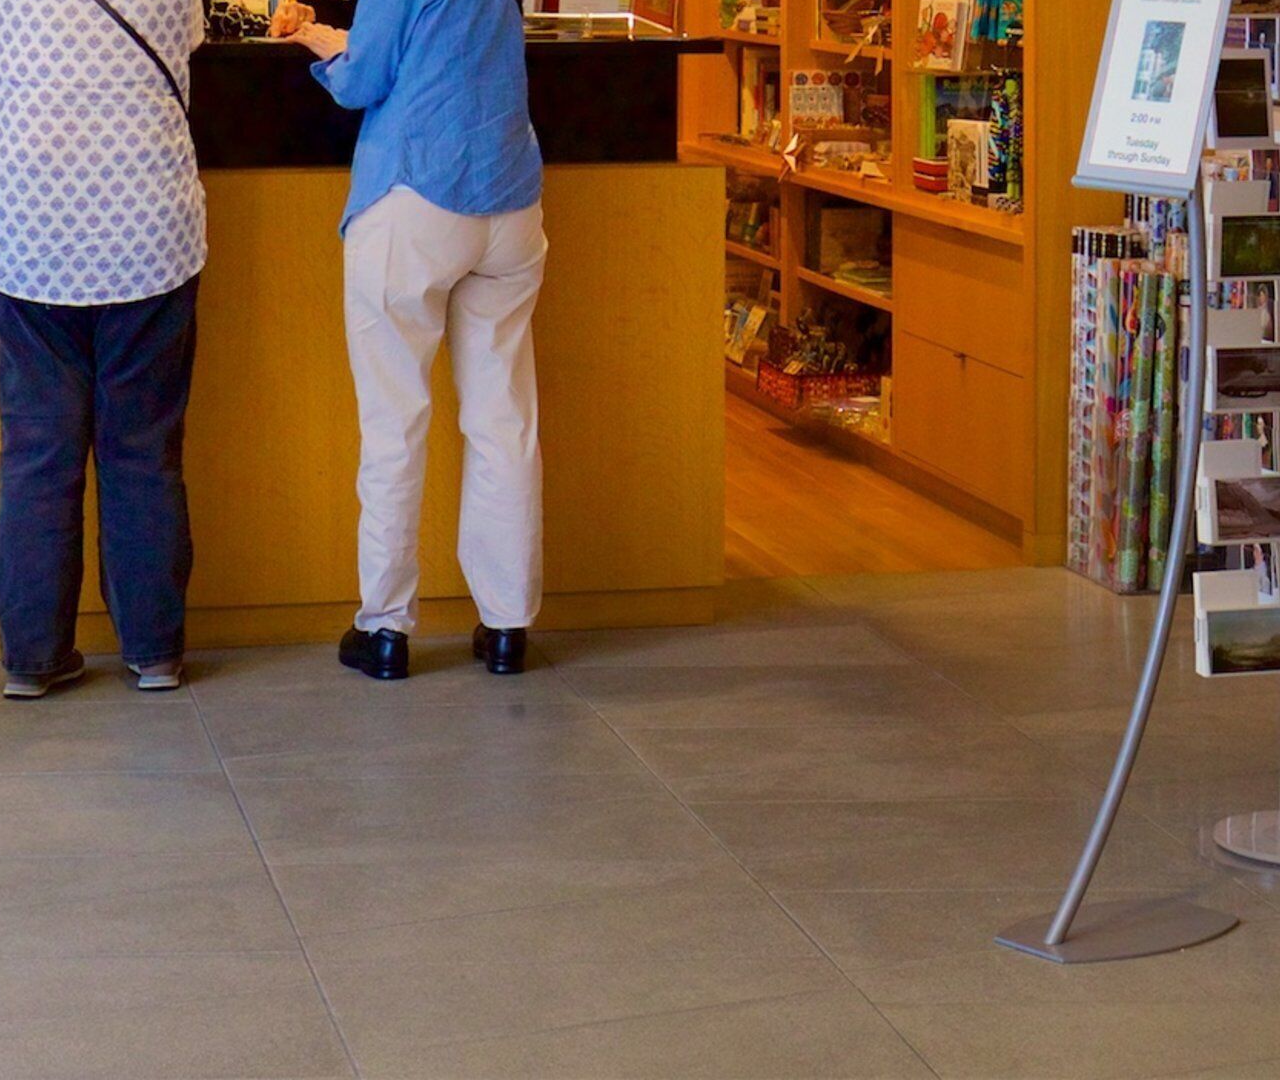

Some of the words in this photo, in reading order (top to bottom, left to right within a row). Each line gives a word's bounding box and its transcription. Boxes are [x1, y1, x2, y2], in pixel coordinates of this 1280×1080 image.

[1130, 112, 1148, 124] 2:00
[1126, 136, 1159, 151] Tuesday
[1107, 150, 1139, 163] through
[1140, 152, 1171, 167] Sunday
